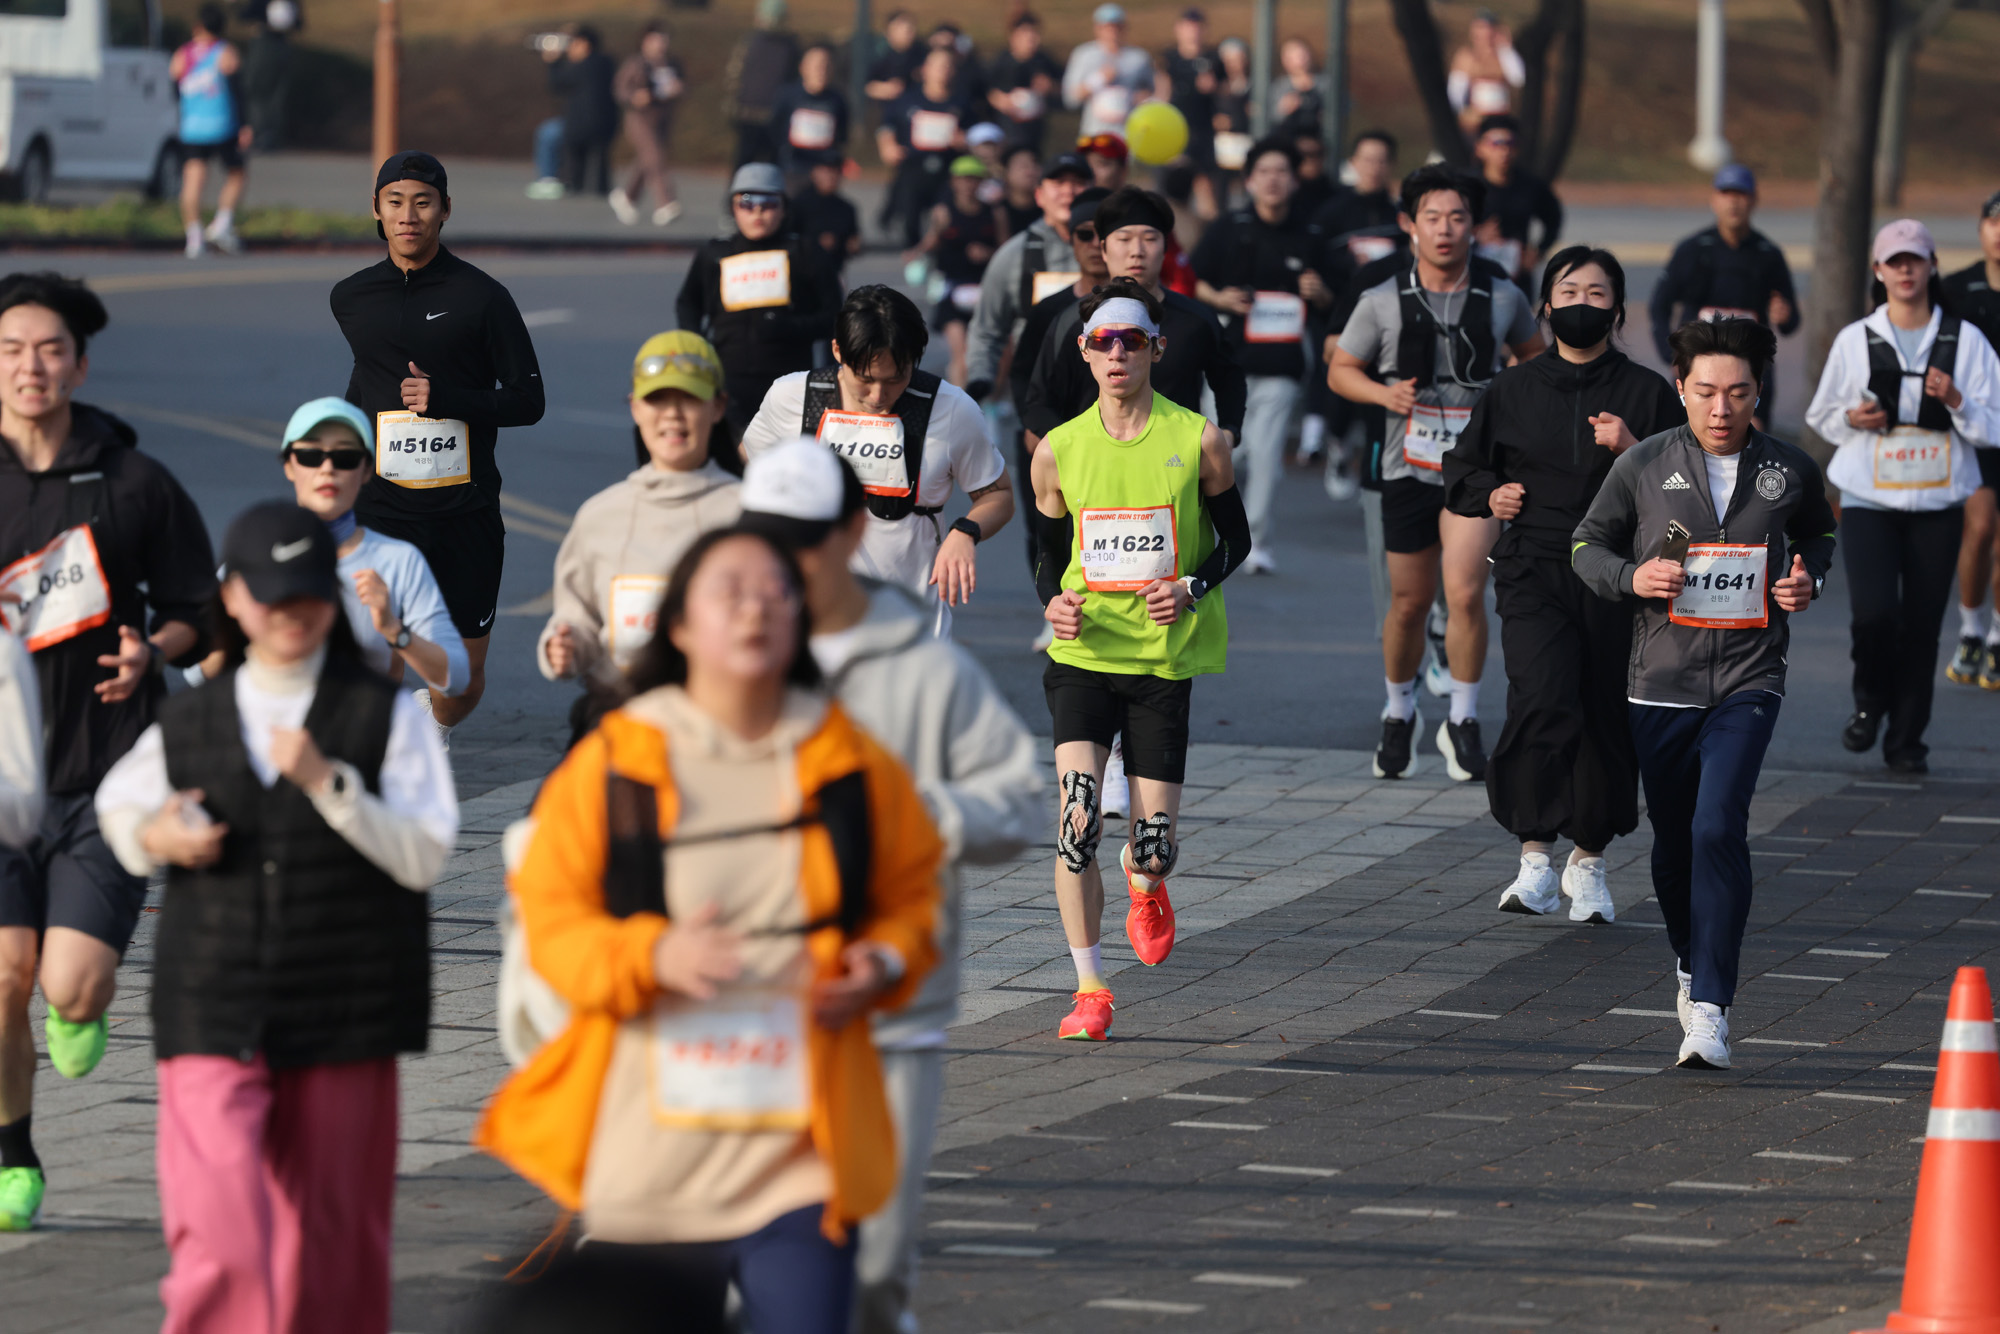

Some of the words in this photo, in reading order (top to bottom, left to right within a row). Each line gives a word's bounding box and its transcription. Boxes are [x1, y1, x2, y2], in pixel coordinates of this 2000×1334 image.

[389, 436, 457, 453] M5164
[829, 442, 903, 460] M1069
[1662, 482, 1690, 490] adidas
[1133, 512, 1155, 520] STORY
[1093, 535, 1165, 552] M1622
[1084, 552, 1116, 562] B-100
[1684, 573, 1756, 590] M1641
